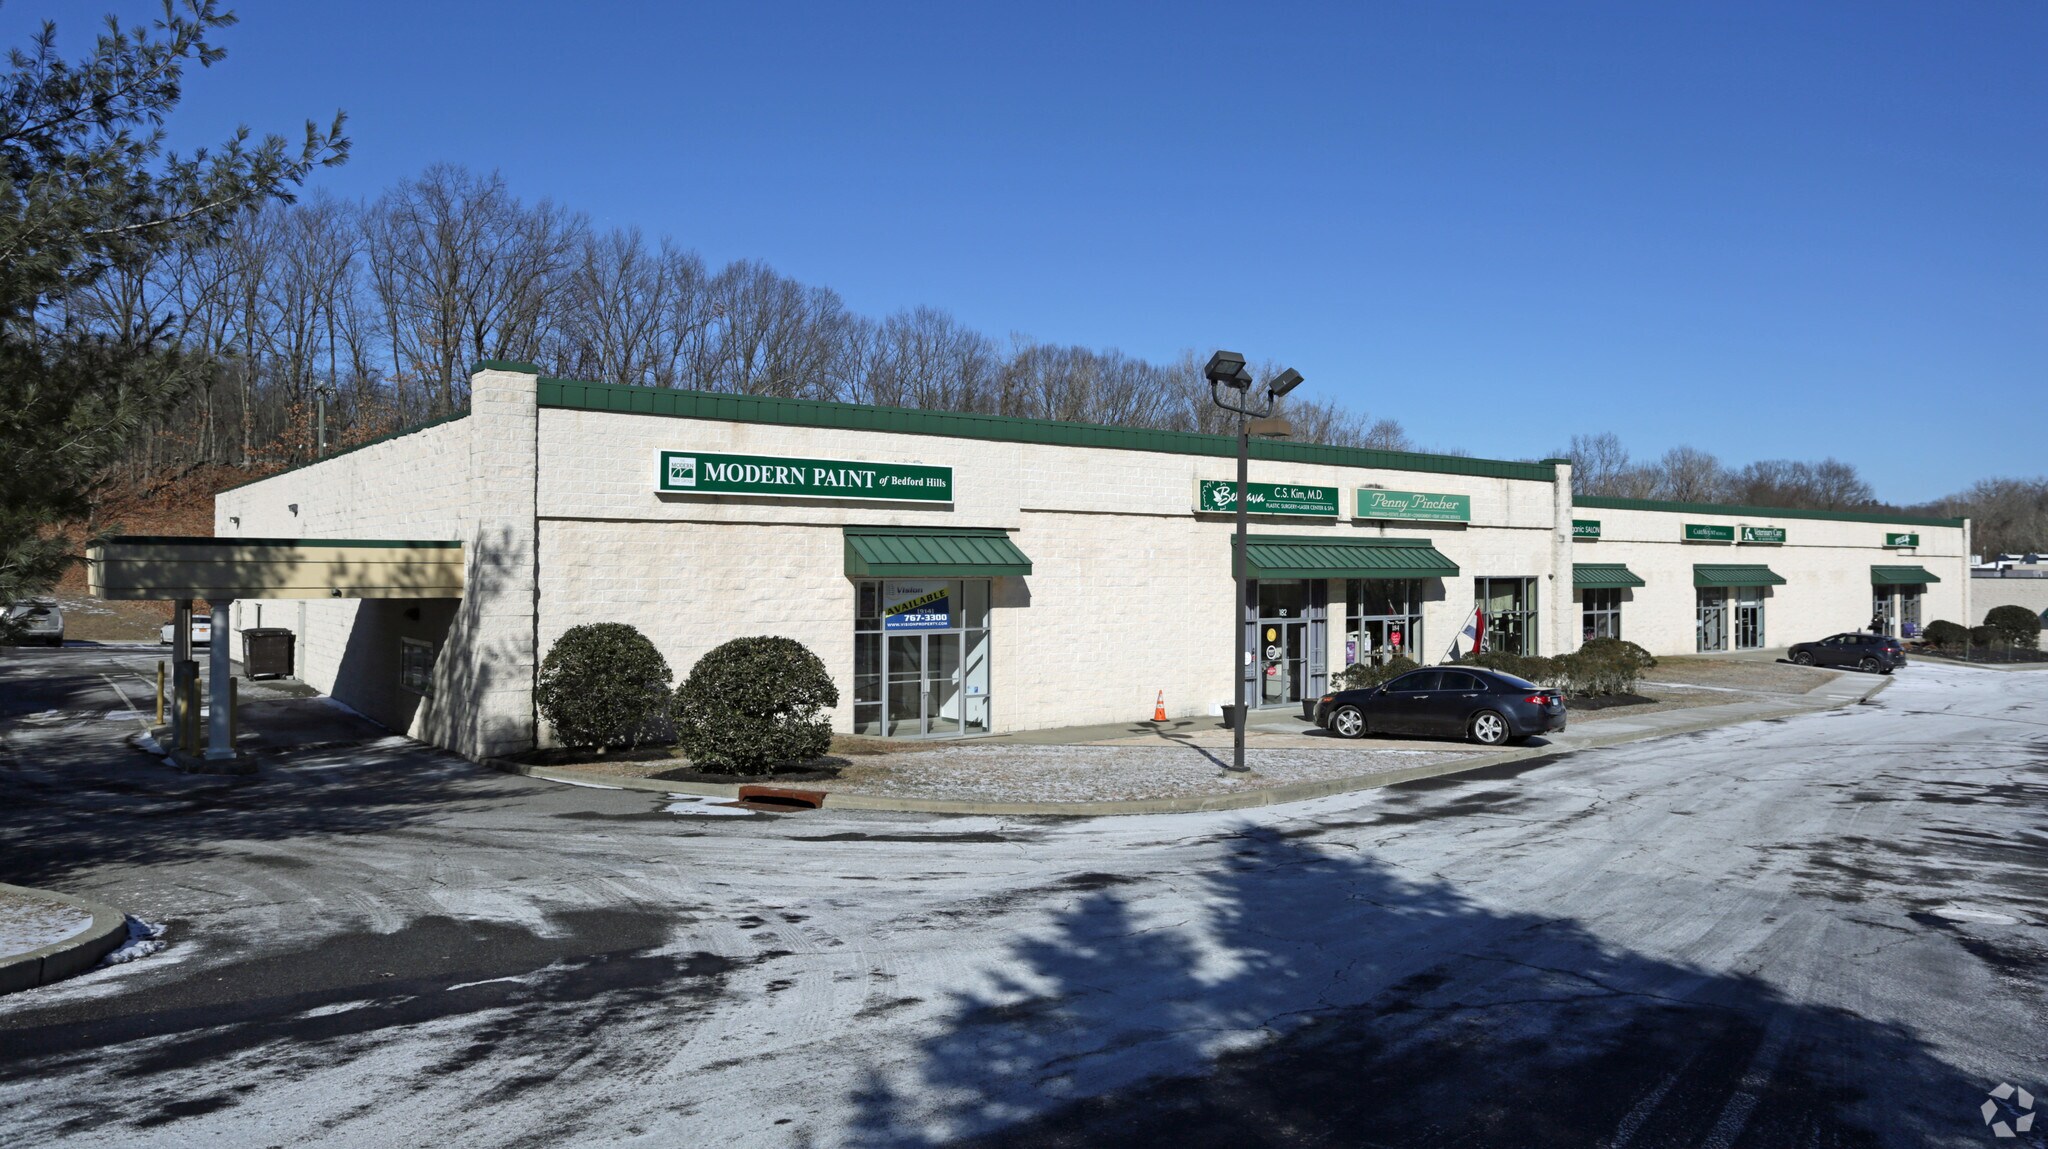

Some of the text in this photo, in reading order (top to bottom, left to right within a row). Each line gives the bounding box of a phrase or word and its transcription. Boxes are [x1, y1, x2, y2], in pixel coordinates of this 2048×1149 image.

[704, 462, 946, 488] MODERN PAINT of Bedford Hills
[1274, 487, 1324, 501] C.S. Kim, M.D.
[1370, 493, 1459, 512] Penny Pincher
[1585, 526, 1600, 534] SALON
[897, 586, 923, 594] Vision
[887, 589, 946, 616] AVAILABLE
[904, 613, 947, 622] 767-3300
